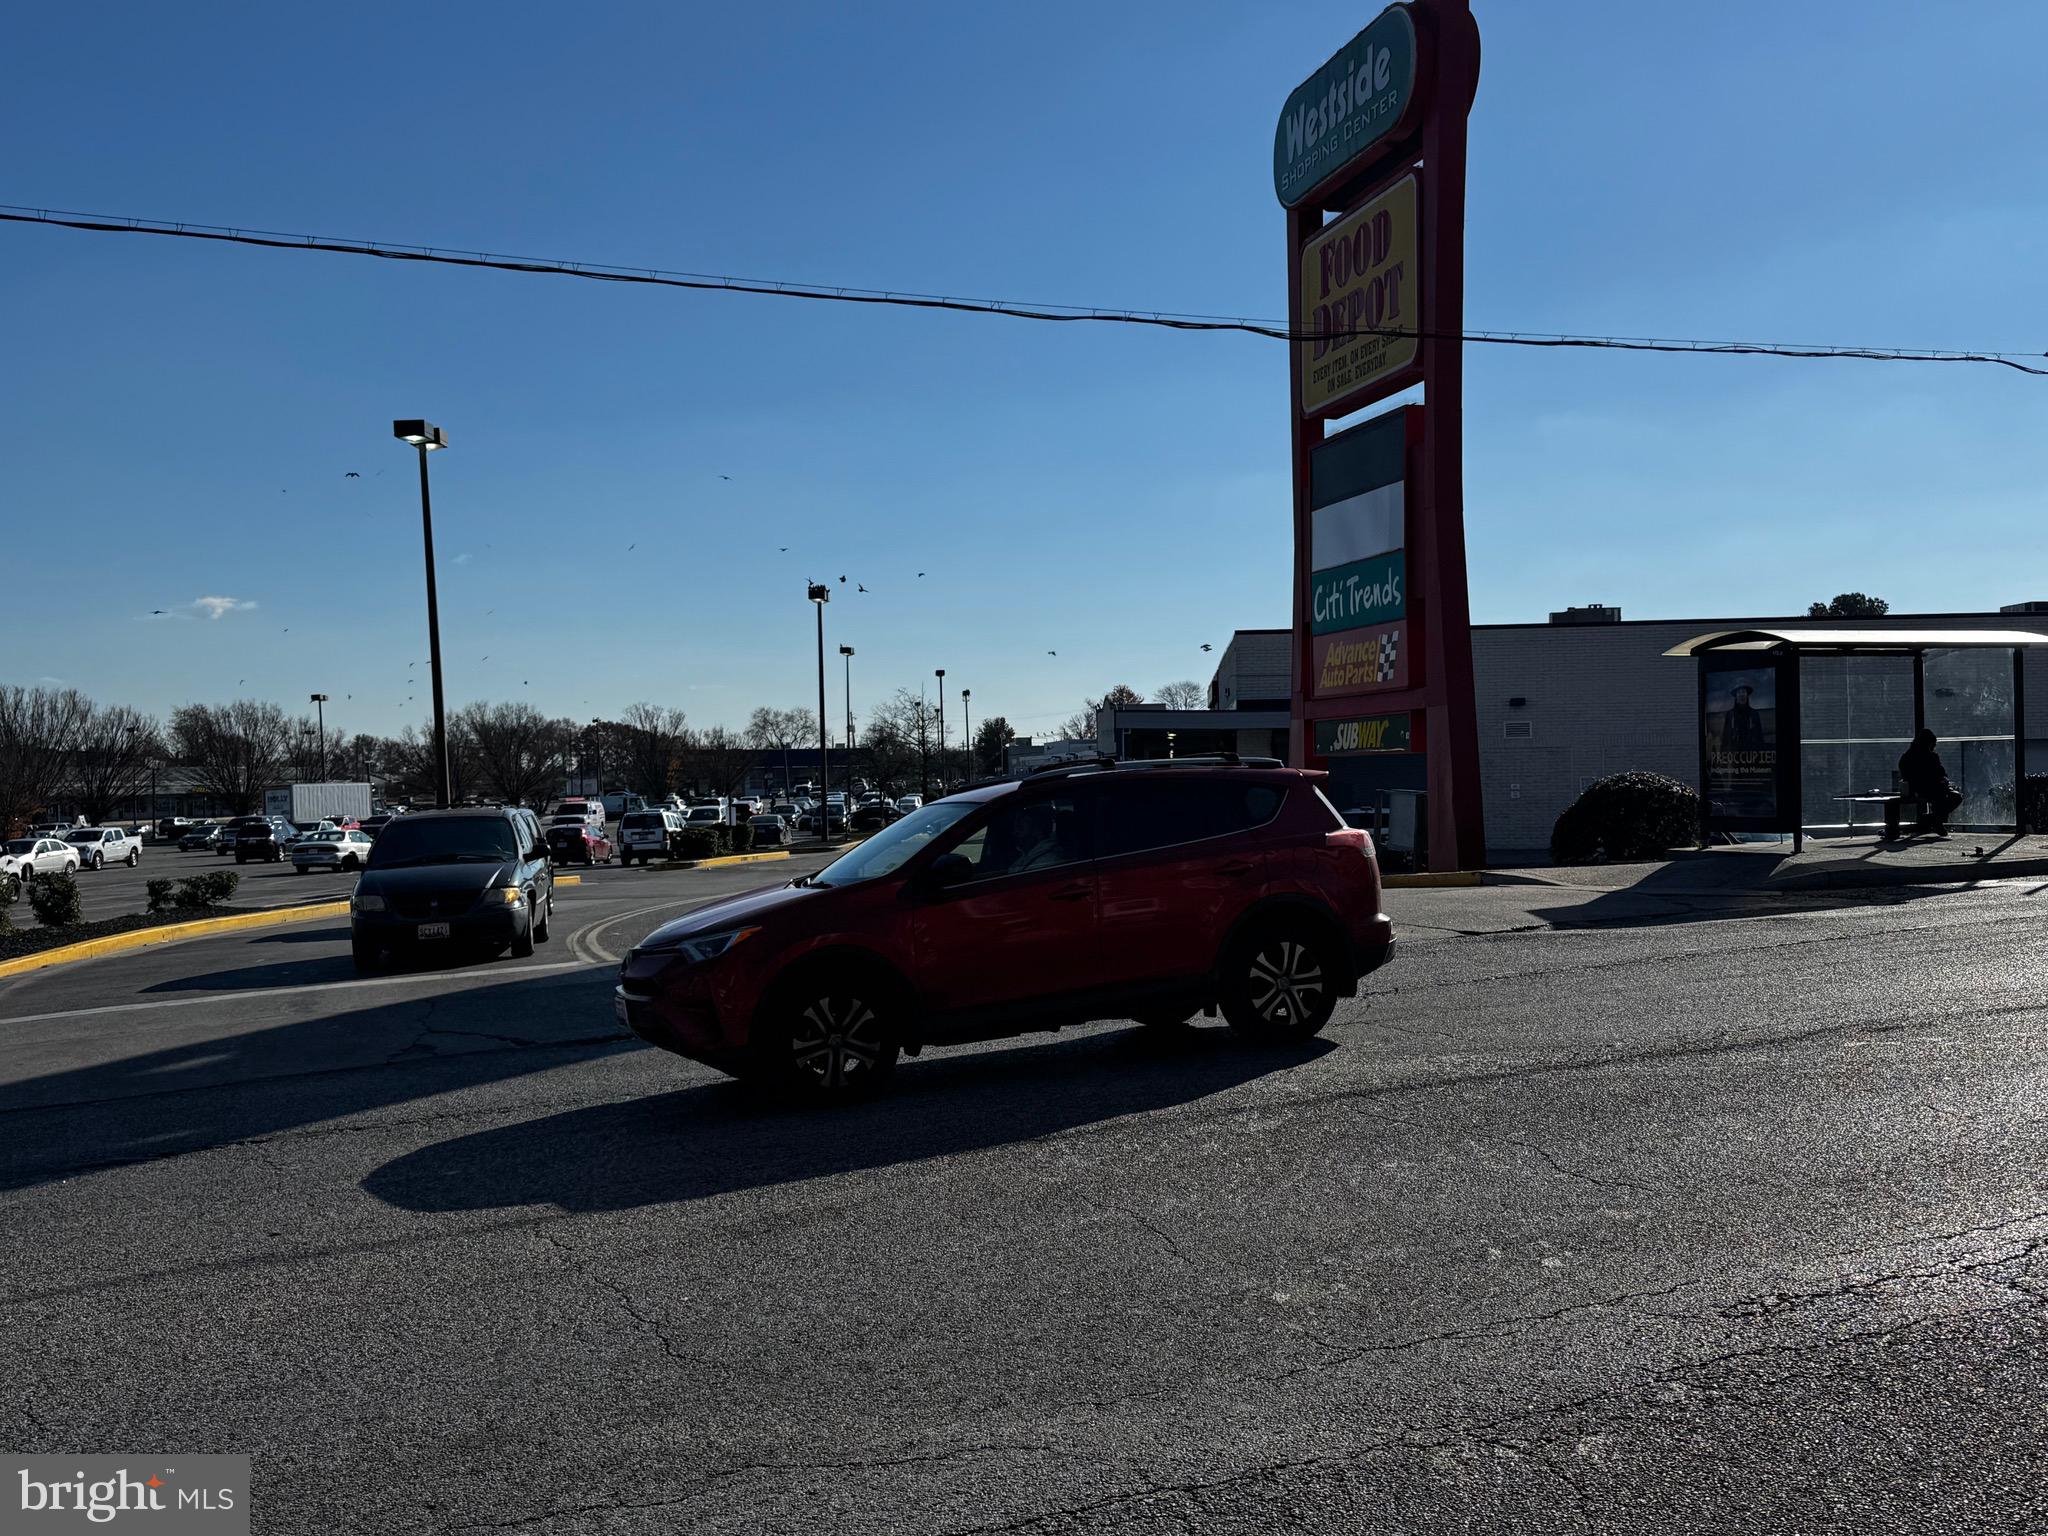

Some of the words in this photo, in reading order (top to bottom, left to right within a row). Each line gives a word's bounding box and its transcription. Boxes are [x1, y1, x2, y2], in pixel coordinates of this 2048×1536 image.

[1286, 40, 1391, 164] Westside
[1281, 137, 1339, 191] SHOPPING
[1343, 89, 1398, 143] CENTER
[1320, 209, 1392, 300] FOOD
[1312, 261, 1404, 361] DEPOT
[1312, 363, 1331, 384] EVERY
[1350, 348, 1359, 364] ON
[1360, 338, 1380, 359] EVERY
[1313, 577, 1344, 622] Citi
[1346, 567, 1402, 616] Trends
[1320, 666, 1344, 688] Auto
[1345, 663, 1374, 685] Parts
[1325, 640, 1376, 667] Advance
[1333, 719, 1389, 750] SUBWAY
